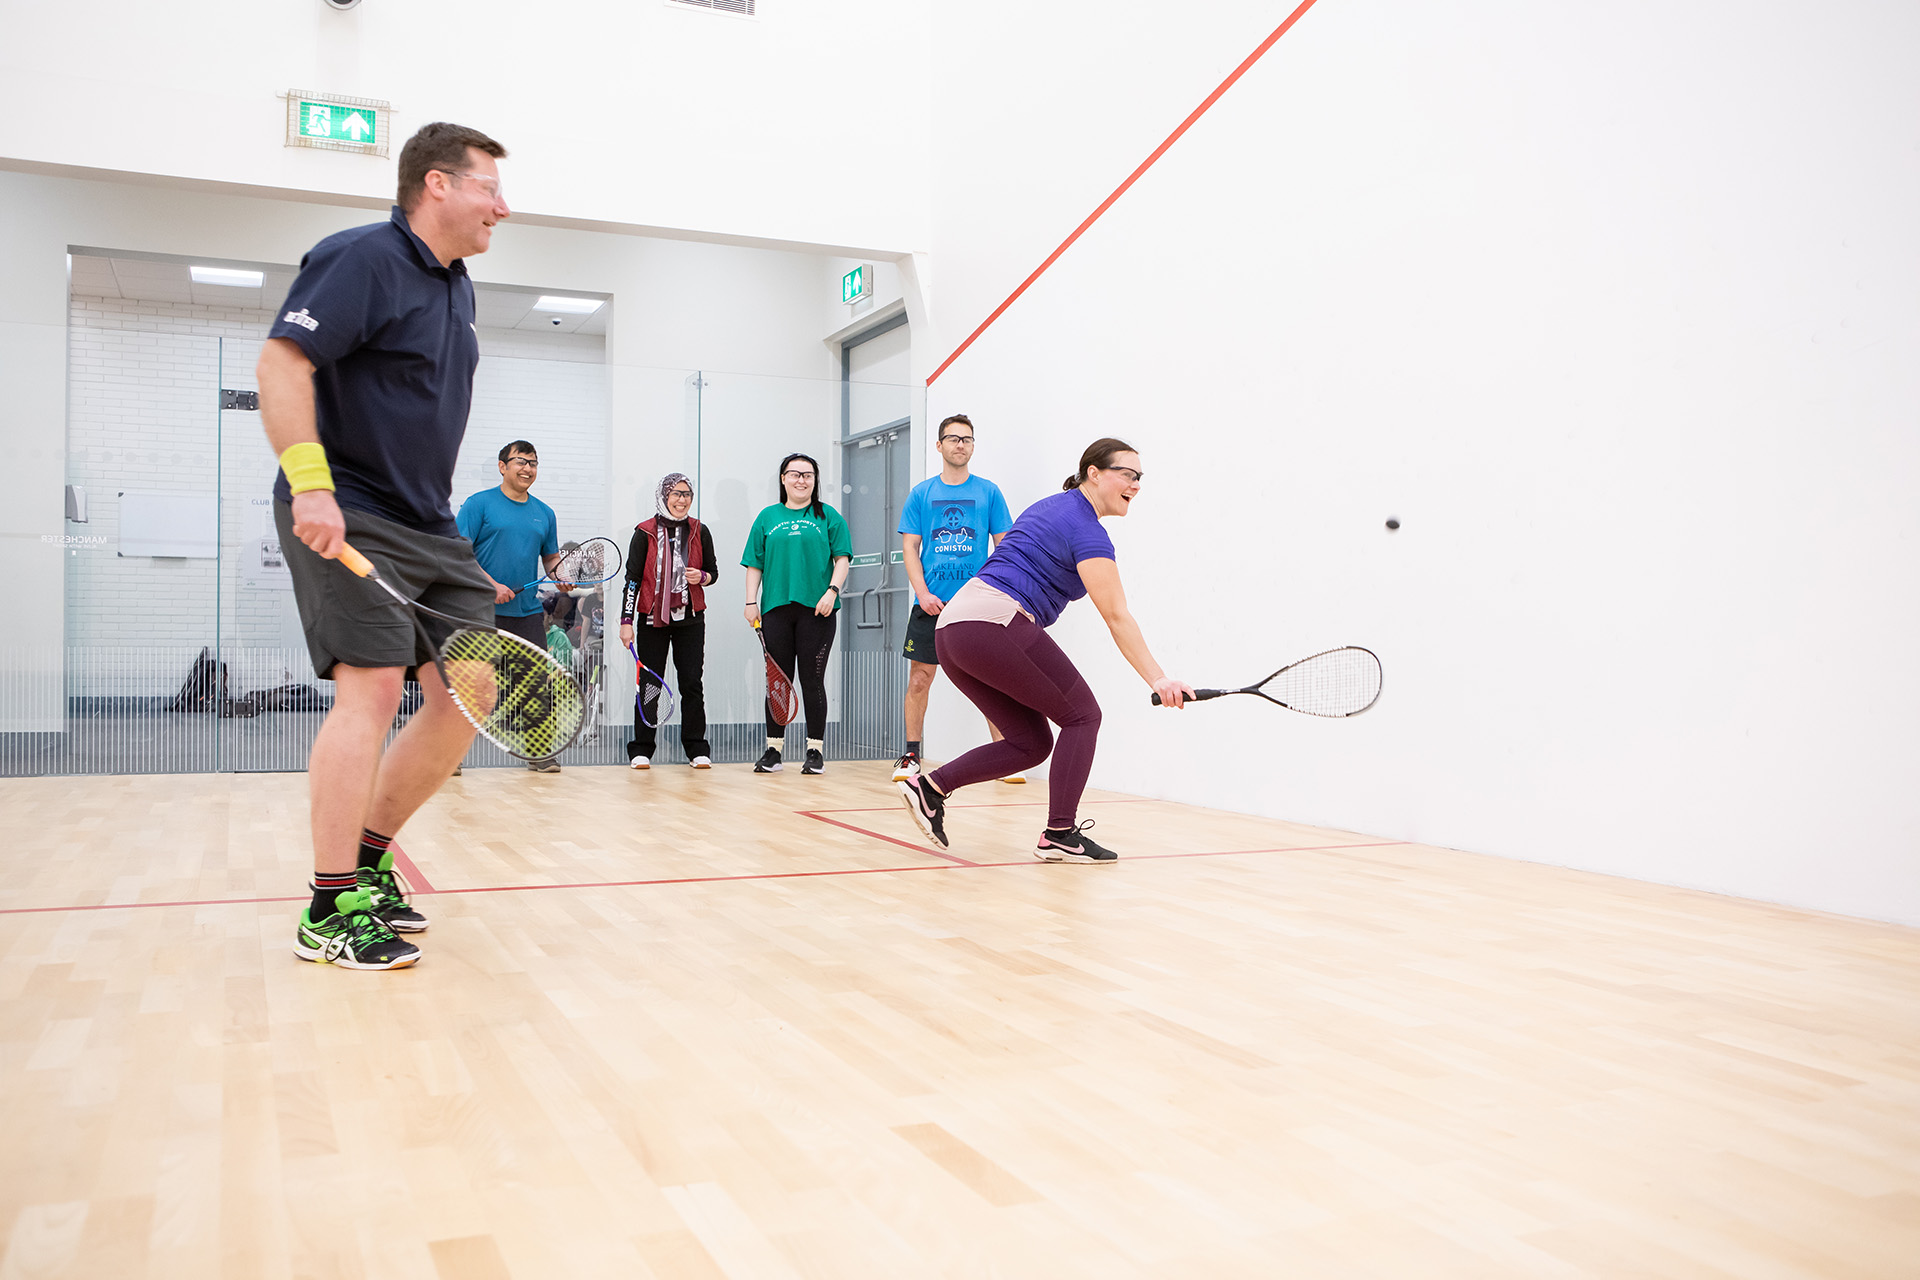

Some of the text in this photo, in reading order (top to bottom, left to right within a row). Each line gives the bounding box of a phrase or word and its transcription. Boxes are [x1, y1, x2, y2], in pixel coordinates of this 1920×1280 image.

[934, 544, 973, 553] CONISTON
[932, 562, 975, 571] LAKELAND
[931, 570, 974, 581] TRAILS
